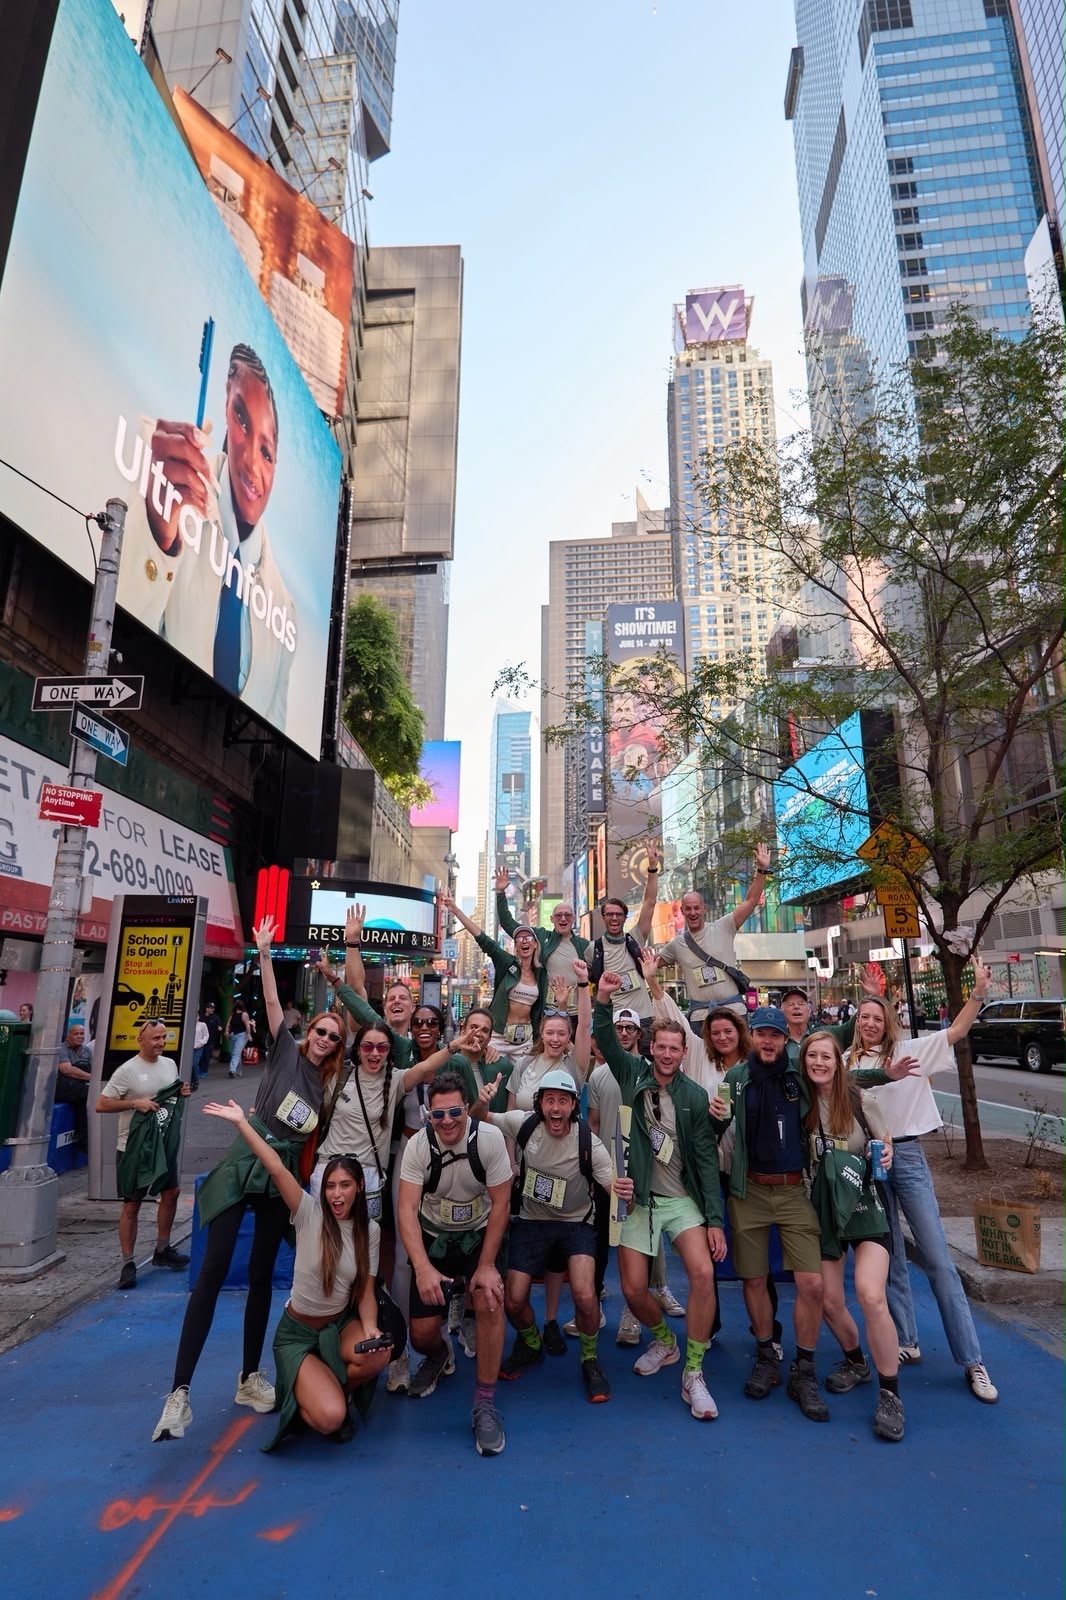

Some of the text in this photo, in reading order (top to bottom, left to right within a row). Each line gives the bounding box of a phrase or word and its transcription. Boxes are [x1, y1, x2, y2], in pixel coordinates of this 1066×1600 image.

[692, 299, 739, 333] W
[114, 415, 209, 555] Ultra
[635, 606, 656, 620] IT'S
[614, 620, 677, 636] SHOWTIME!
[619, 639, 635, 648] JUNE
[636, 639, 643, 648] 14
[665, 638, 673, 647] 13
[49, 686, 126, 700] ONE WAY
[81, 716, 121, 751] ONE WAY
[589, 711, 604, 800] QUARE
[45, 787, 93, 802] NO STOPPING
[45, 796, 75, 807] Anytime
[103, 808, 148, 847] FOR
[160, 828, 222, 877] LEASE
[52, 828, 194, 896] 2-689-0099
[888, 894, 910, 902] ROAD
[895, 907, 909, 924] 5
[76, 922, 107, 939] LAD
[308, 926, 406, 945] RESTURANT
[411, 934, 418, 946] &
[128, 934, 168, 946] School
[126, 946, 167, 959] is Open
[445, 949, 455, 958] 10
[125, 960, 143, 968] Stop
[124, 968, 169, 976] Crosswalks
[841, 1169, 860, 1188] WALK
[978, 1215, 997, 1227] IT'S
[980, 1226, 1017, 1242] WHAT'S
[981, 1238, 1011, 1254] NOT IN
[982, 1249, 1001, 1262] THE
